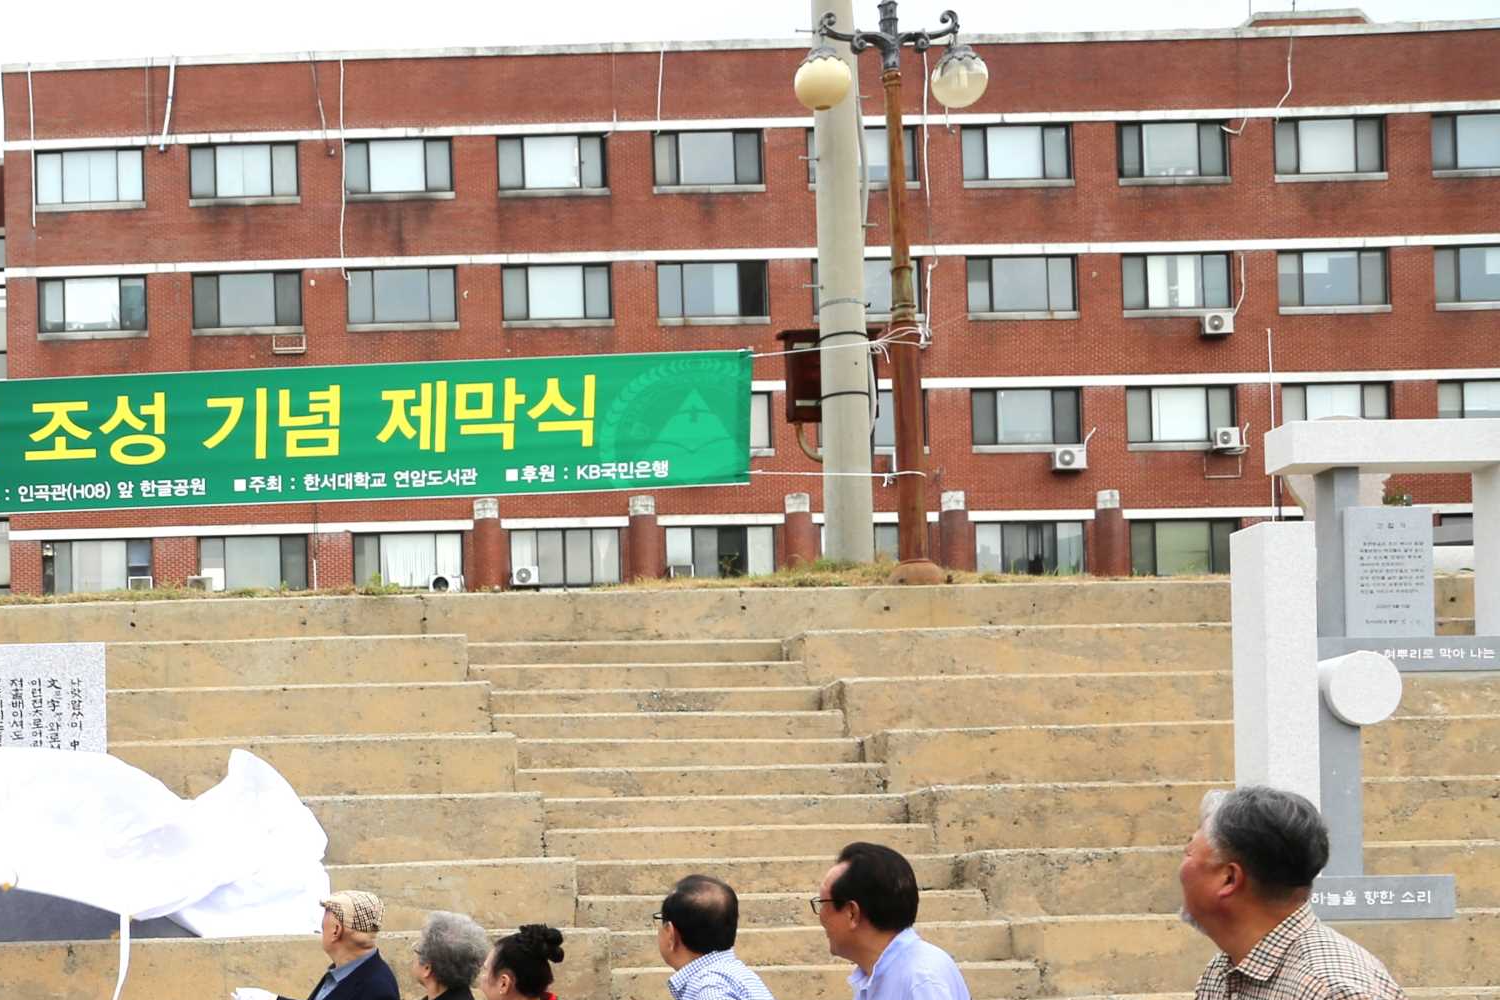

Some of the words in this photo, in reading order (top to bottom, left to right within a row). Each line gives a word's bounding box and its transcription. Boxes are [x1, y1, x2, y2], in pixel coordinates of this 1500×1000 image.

[24, 392, 166, 465] 조성
[203, 384, 341, 459] 기념
[376, 374, 596, 453] 제막식
[248, 475, 282, 494] 주최
[303, 471, 387, 492] 한서대학교
[393, 467, 478, 488] 연암도서관
[520, 464, 555, 483] 후원
[576, 460, 669, 480] KB국민은행
[18, 480, 111, 503] 인곡관(H08)
[117, 480, 134, 499] 앞
[139, 478, 206, 498] 한글공원
[1440, 647, 1466, 660] 막아
[1470, 647, 1495, 660] 나는
[1311, 889, 1357, 906] 하늘을
[1363, 889, 1395, 905] 향한
[1400, 889, 1431, 904] 소리
